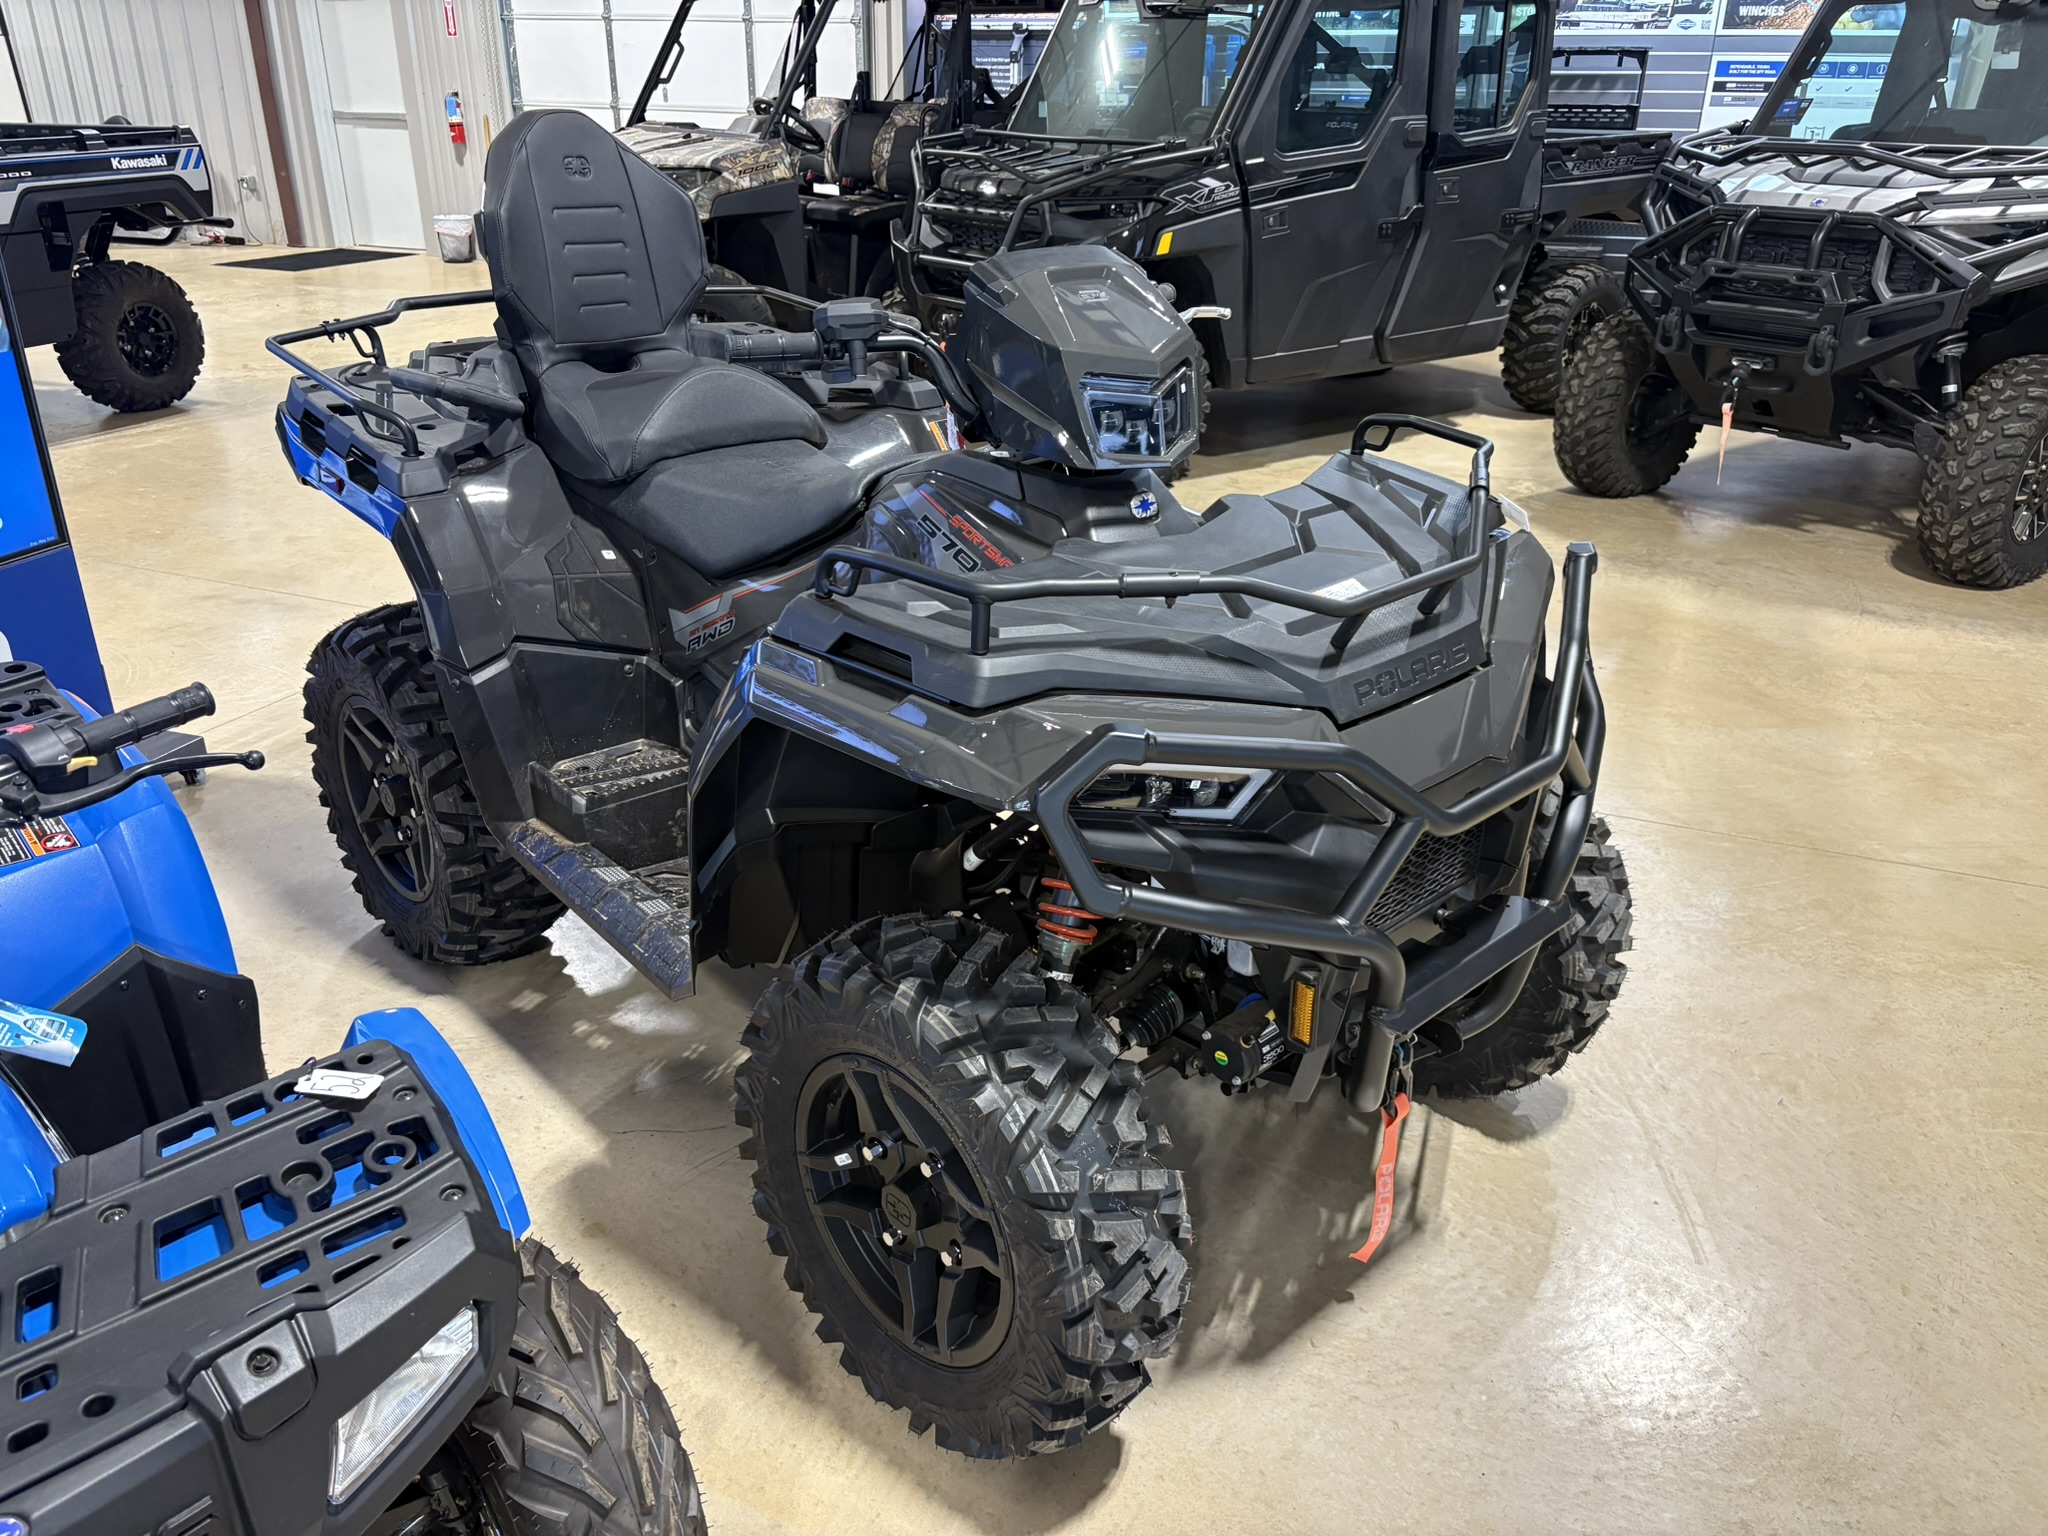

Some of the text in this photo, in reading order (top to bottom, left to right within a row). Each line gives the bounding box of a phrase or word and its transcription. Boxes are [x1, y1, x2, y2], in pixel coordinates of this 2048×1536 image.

[1739, 5, 1785, 16] WINCHES
[110, 154, 168, 170] Kawasaki
[733, 148, 783, 169] XP
[739, 161, 778, 176] 1000
[1571, 155, 1637, 173] RANGER
[1164, 182, 1235, 216] XP
[917, 513, 981, 573] 570
[686, 617, 736, 655] AWD
[1352, 643, 1470, 707] POLARIS
[309, 1075, 375, 1095] 52
[1371, 1162, 1394, 1243] POLARIS
